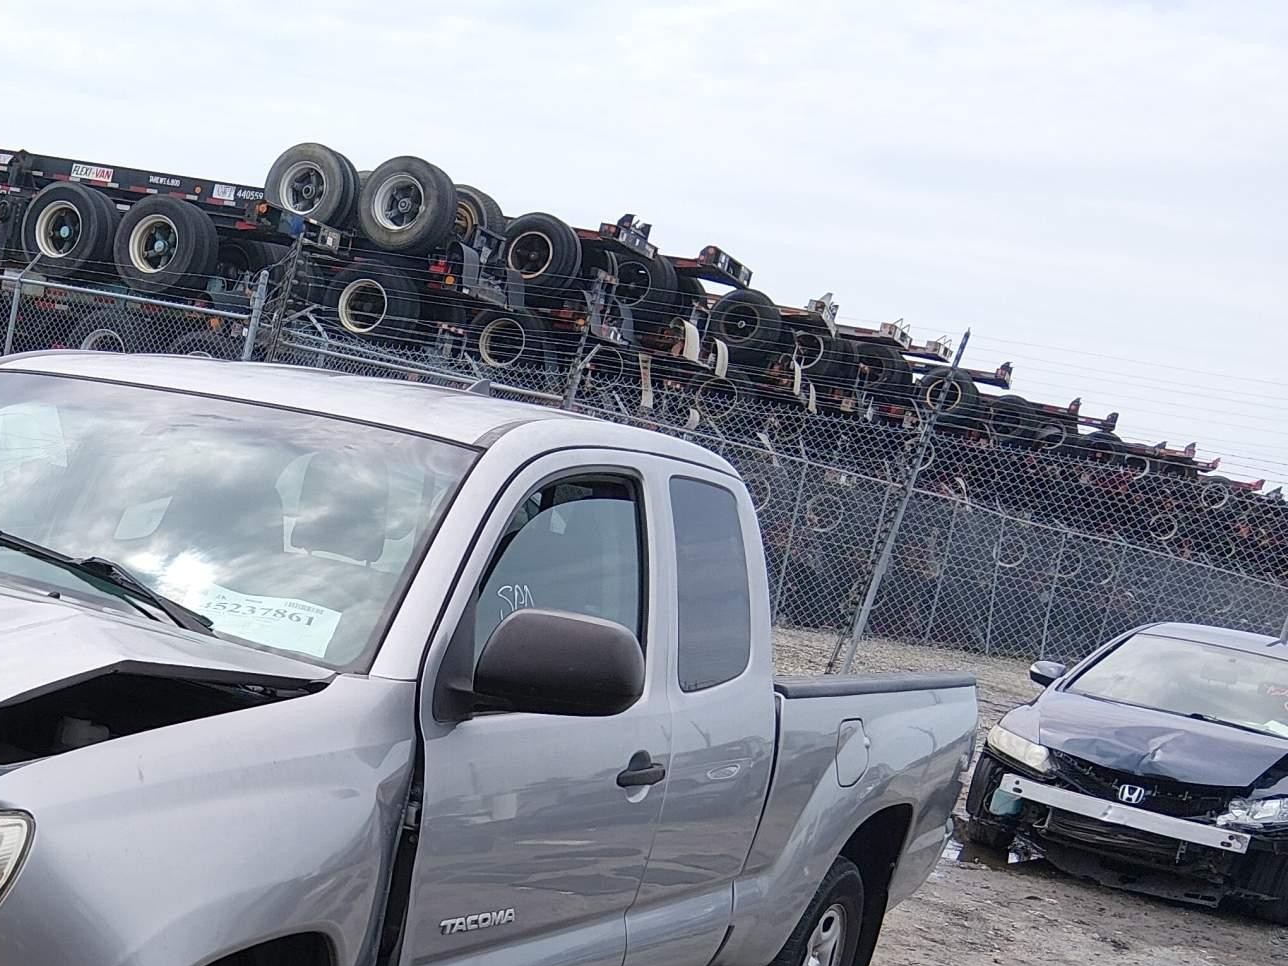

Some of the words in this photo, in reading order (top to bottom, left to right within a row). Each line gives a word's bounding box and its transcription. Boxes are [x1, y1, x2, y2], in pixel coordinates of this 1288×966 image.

[72, 164, 113, 181] FLEXI-VAN
[236, 188, 264, 201] 440559
[440, 908, 516, 936] TACOMA
